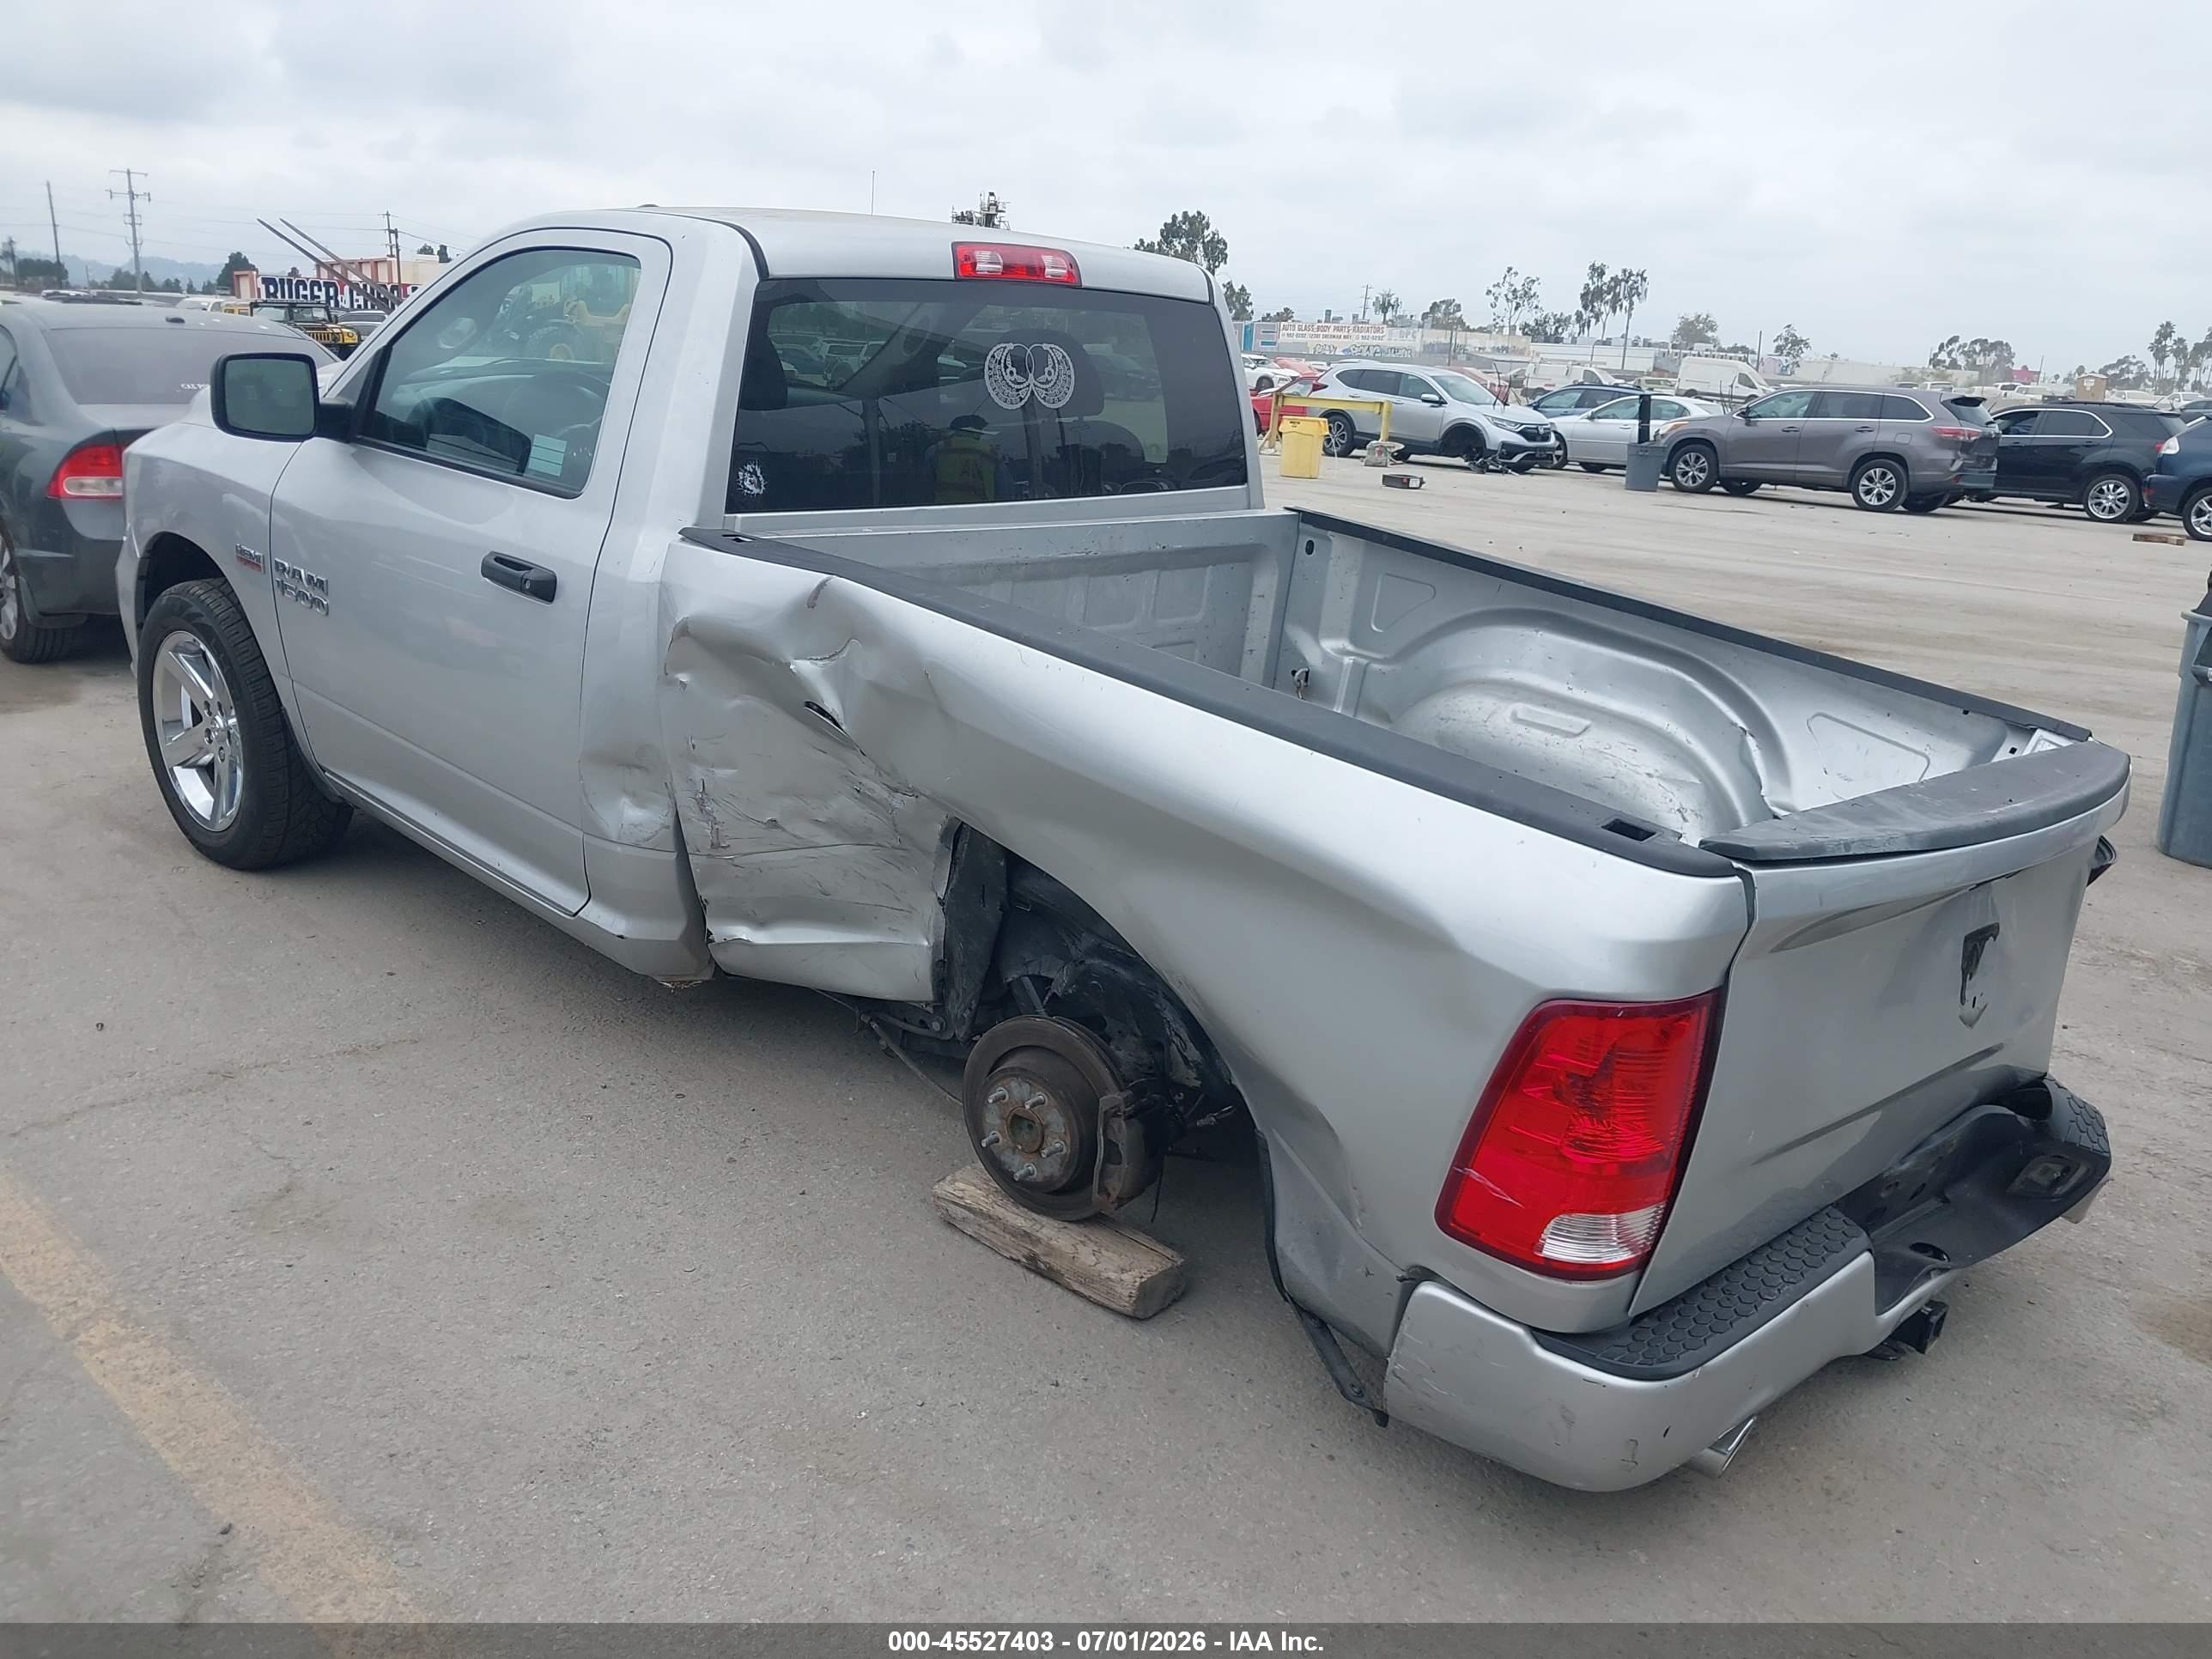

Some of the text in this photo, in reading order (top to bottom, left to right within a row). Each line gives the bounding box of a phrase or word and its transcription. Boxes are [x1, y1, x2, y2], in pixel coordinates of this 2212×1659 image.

[235, 543, 263, 567] HEMI
[274, 557, 329, 596] RAM
[275, 577, 330, 617] 1500
